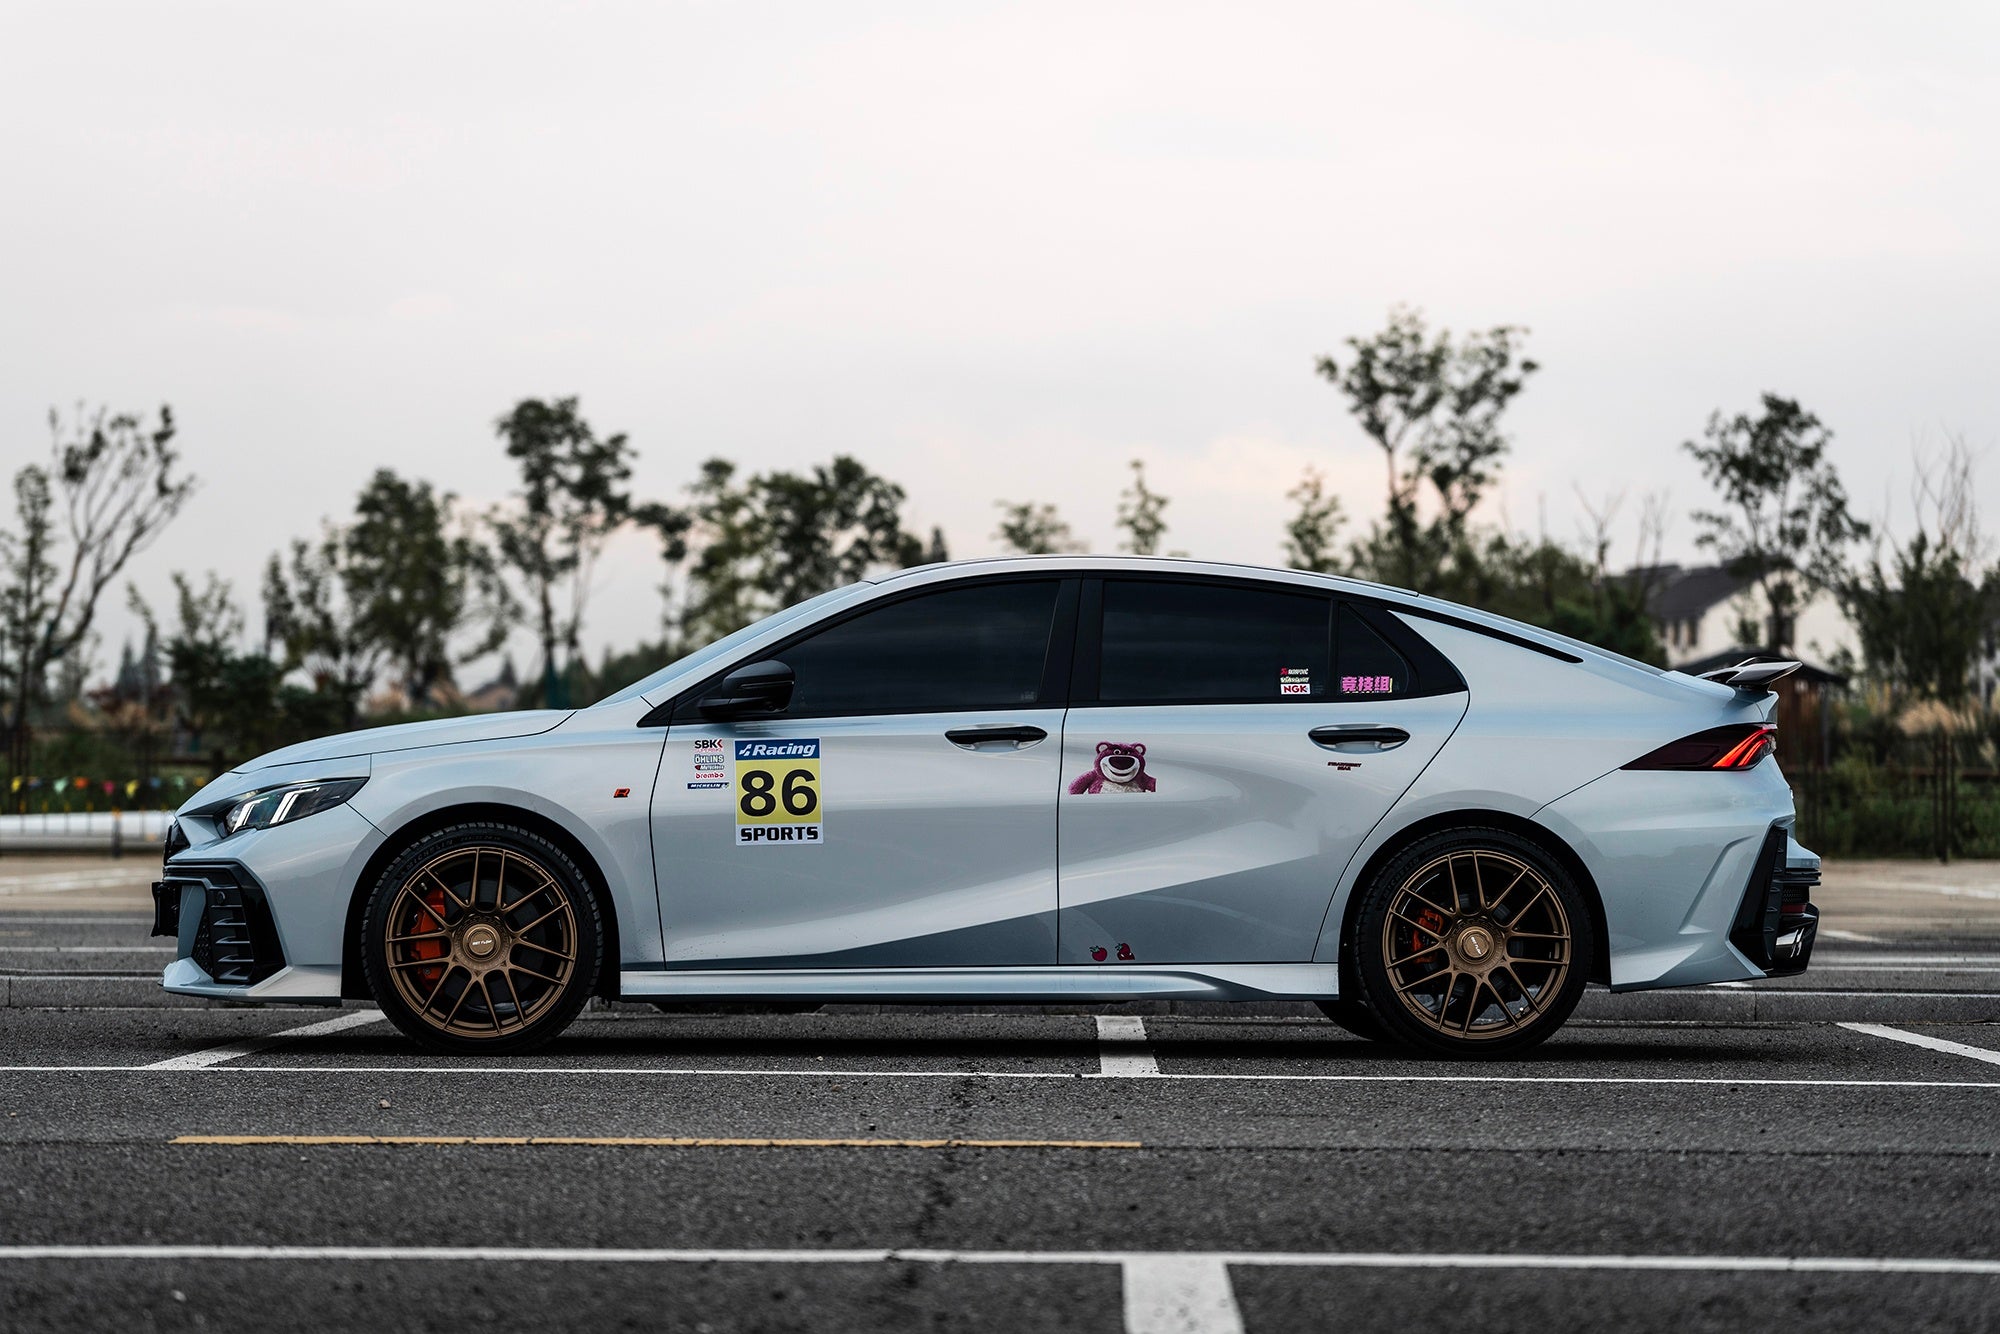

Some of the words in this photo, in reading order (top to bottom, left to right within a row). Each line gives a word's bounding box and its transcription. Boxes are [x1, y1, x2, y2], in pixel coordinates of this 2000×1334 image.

[1283, 684, 1308, 694] NGK
[694, 739, 719, 749] SBK
[752, 742, 817, 758] Racing
[694, 754, 725, 764] ÖHLINS
[740, 769, 818, 817] 86
[741, 826, 819, 842] SPORTS
